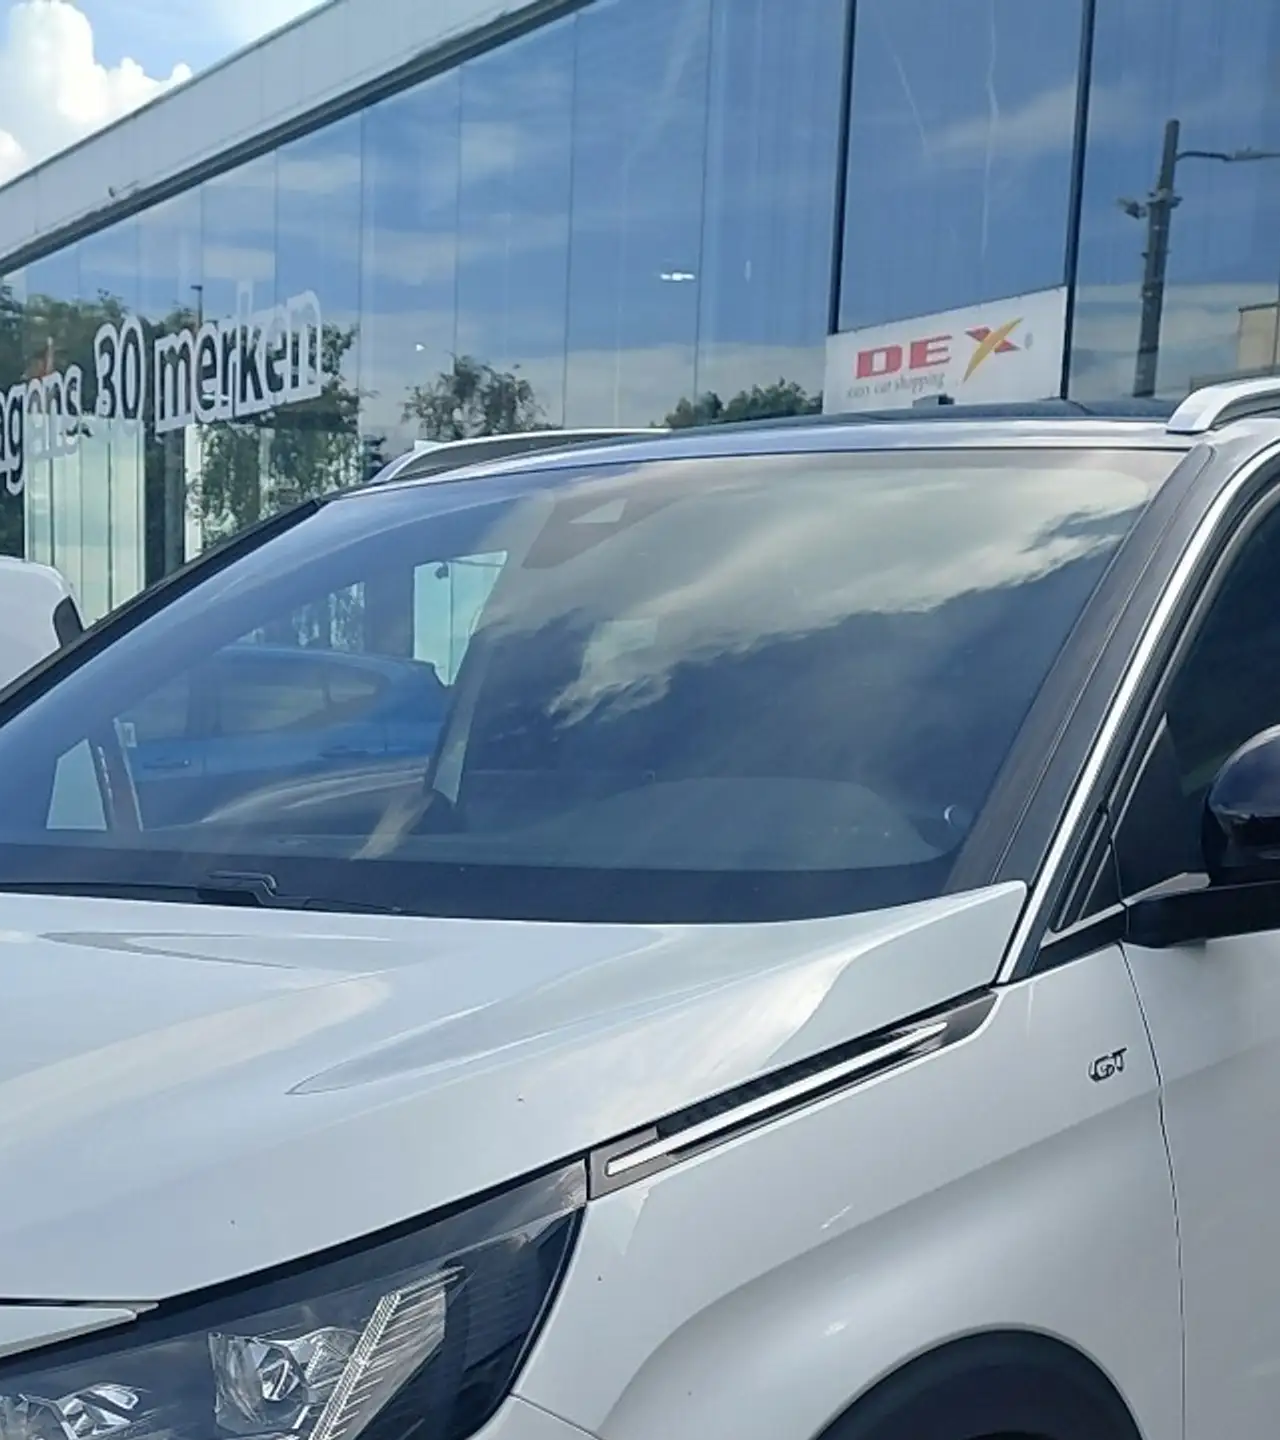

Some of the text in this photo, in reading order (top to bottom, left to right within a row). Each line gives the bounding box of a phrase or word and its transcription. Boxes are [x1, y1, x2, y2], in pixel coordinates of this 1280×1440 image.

[154, 282, 322, 433] merken
[855, 317, 1023, 383] DEX
[1088, 1046, 1128, 1083] GT
